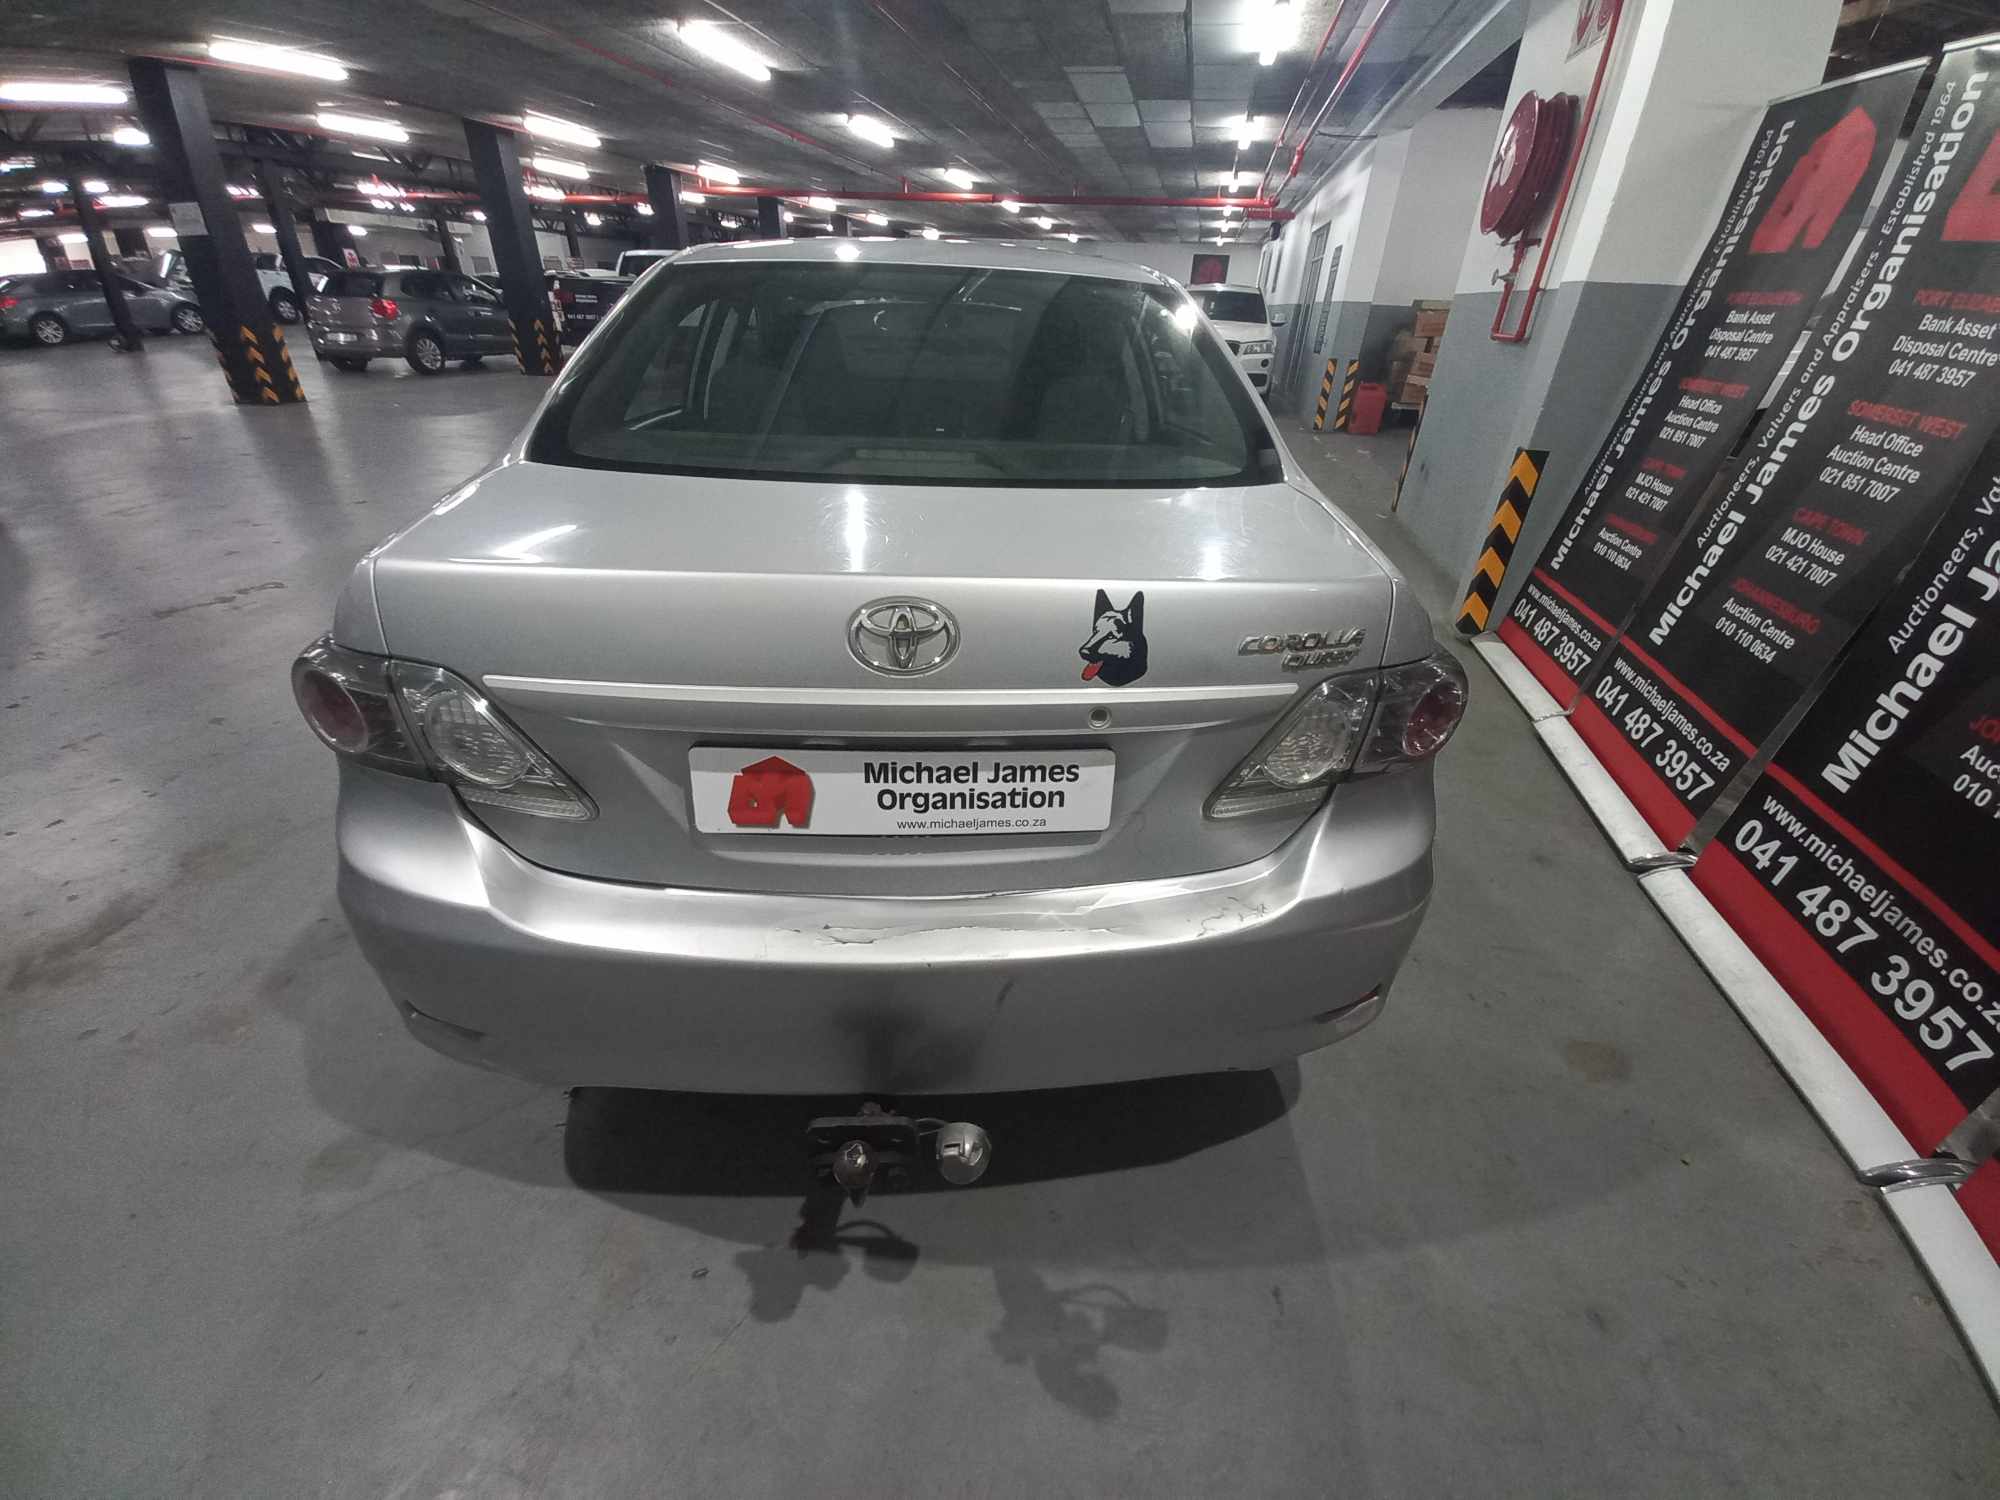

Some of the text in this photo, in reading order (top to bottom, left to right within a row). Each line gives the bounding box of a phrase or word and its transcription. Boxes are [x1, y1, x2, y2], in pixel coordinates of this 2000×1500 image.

[1713, 170, 1757, 254] Established
[1755, 129, 1774, 165] 1964
[1696, 455, 1761, 549] Auctioneers,
[1757, 387, 1801, 448] Valuers
[1800, 348, 1824, 384] and
[1822, 251, 1880, 346] Appraisers
[1881, 131, 1935, 235] Established
[1930, 81, 1957, 126] 1964
[1726, 310, 1776, 325] Bank Asset
[1918, 313, 1997, 340] Bank Asset
[1551, 465, 1615, 570] Michael
[1615, 360, 1672, 460] James
[1671, 120, 1797, 350] Organisation
[1708, 328, 1774, 344] Disposal Centre
[1892, 335, 1998, 367] Disposal Centre
[1648, 510, 1746, 646] Michael
[1745, 374, 1836, 505] James
[1832, 72, 1989, 362] Organisation
[1888, 358, 1977, 388] 041 487 3957
[1664, 410, 1720, 433] Auction Centre
[1679, 395, 1723, 415] Head Office
[1850, 424, 1924, 458] Head Office
[1827, 444, 1921, 484] Auction Centre
[1650, 478, 1674, 496] House
[1819, 466, 1901, 503] 021 851 7007
[1598, 527, 1623, 547] Auction
[1620, 539, 1642, 558] Centre
[1780, 527, 1845, 566] MJO House
[1765, 545, 1837, 587] 021 421 7007
[1887, 526, 1985, 654] Auctioneers,
[1514, 598, 1593, 676] 041 487 3957
[1527, 583, 1602, 652] www.michaeljames.co.za
[1723, 597, 1762, 628] Auction
[1759, 619, 1796, 650] Centre
[1715, 616, 1777, 664] 010 110 0634
[1614, 656, 1731, 773] www.michaeljames.co.za
[1821, 603, 1977, 795] Michael
[1595, 676, 1715, 800] 041 487 3957
[864, 761, 1080, 784] Michael James
[1960, 745, 2000, 784] Auc
[877, 787, 1065, 814] Organisation
[1953, 774, 1993, 807] 010
[897, 817, 1047, 830] www.michaeljames.co.za
[1735, 819, 1995, 1072] 041 487 3957
